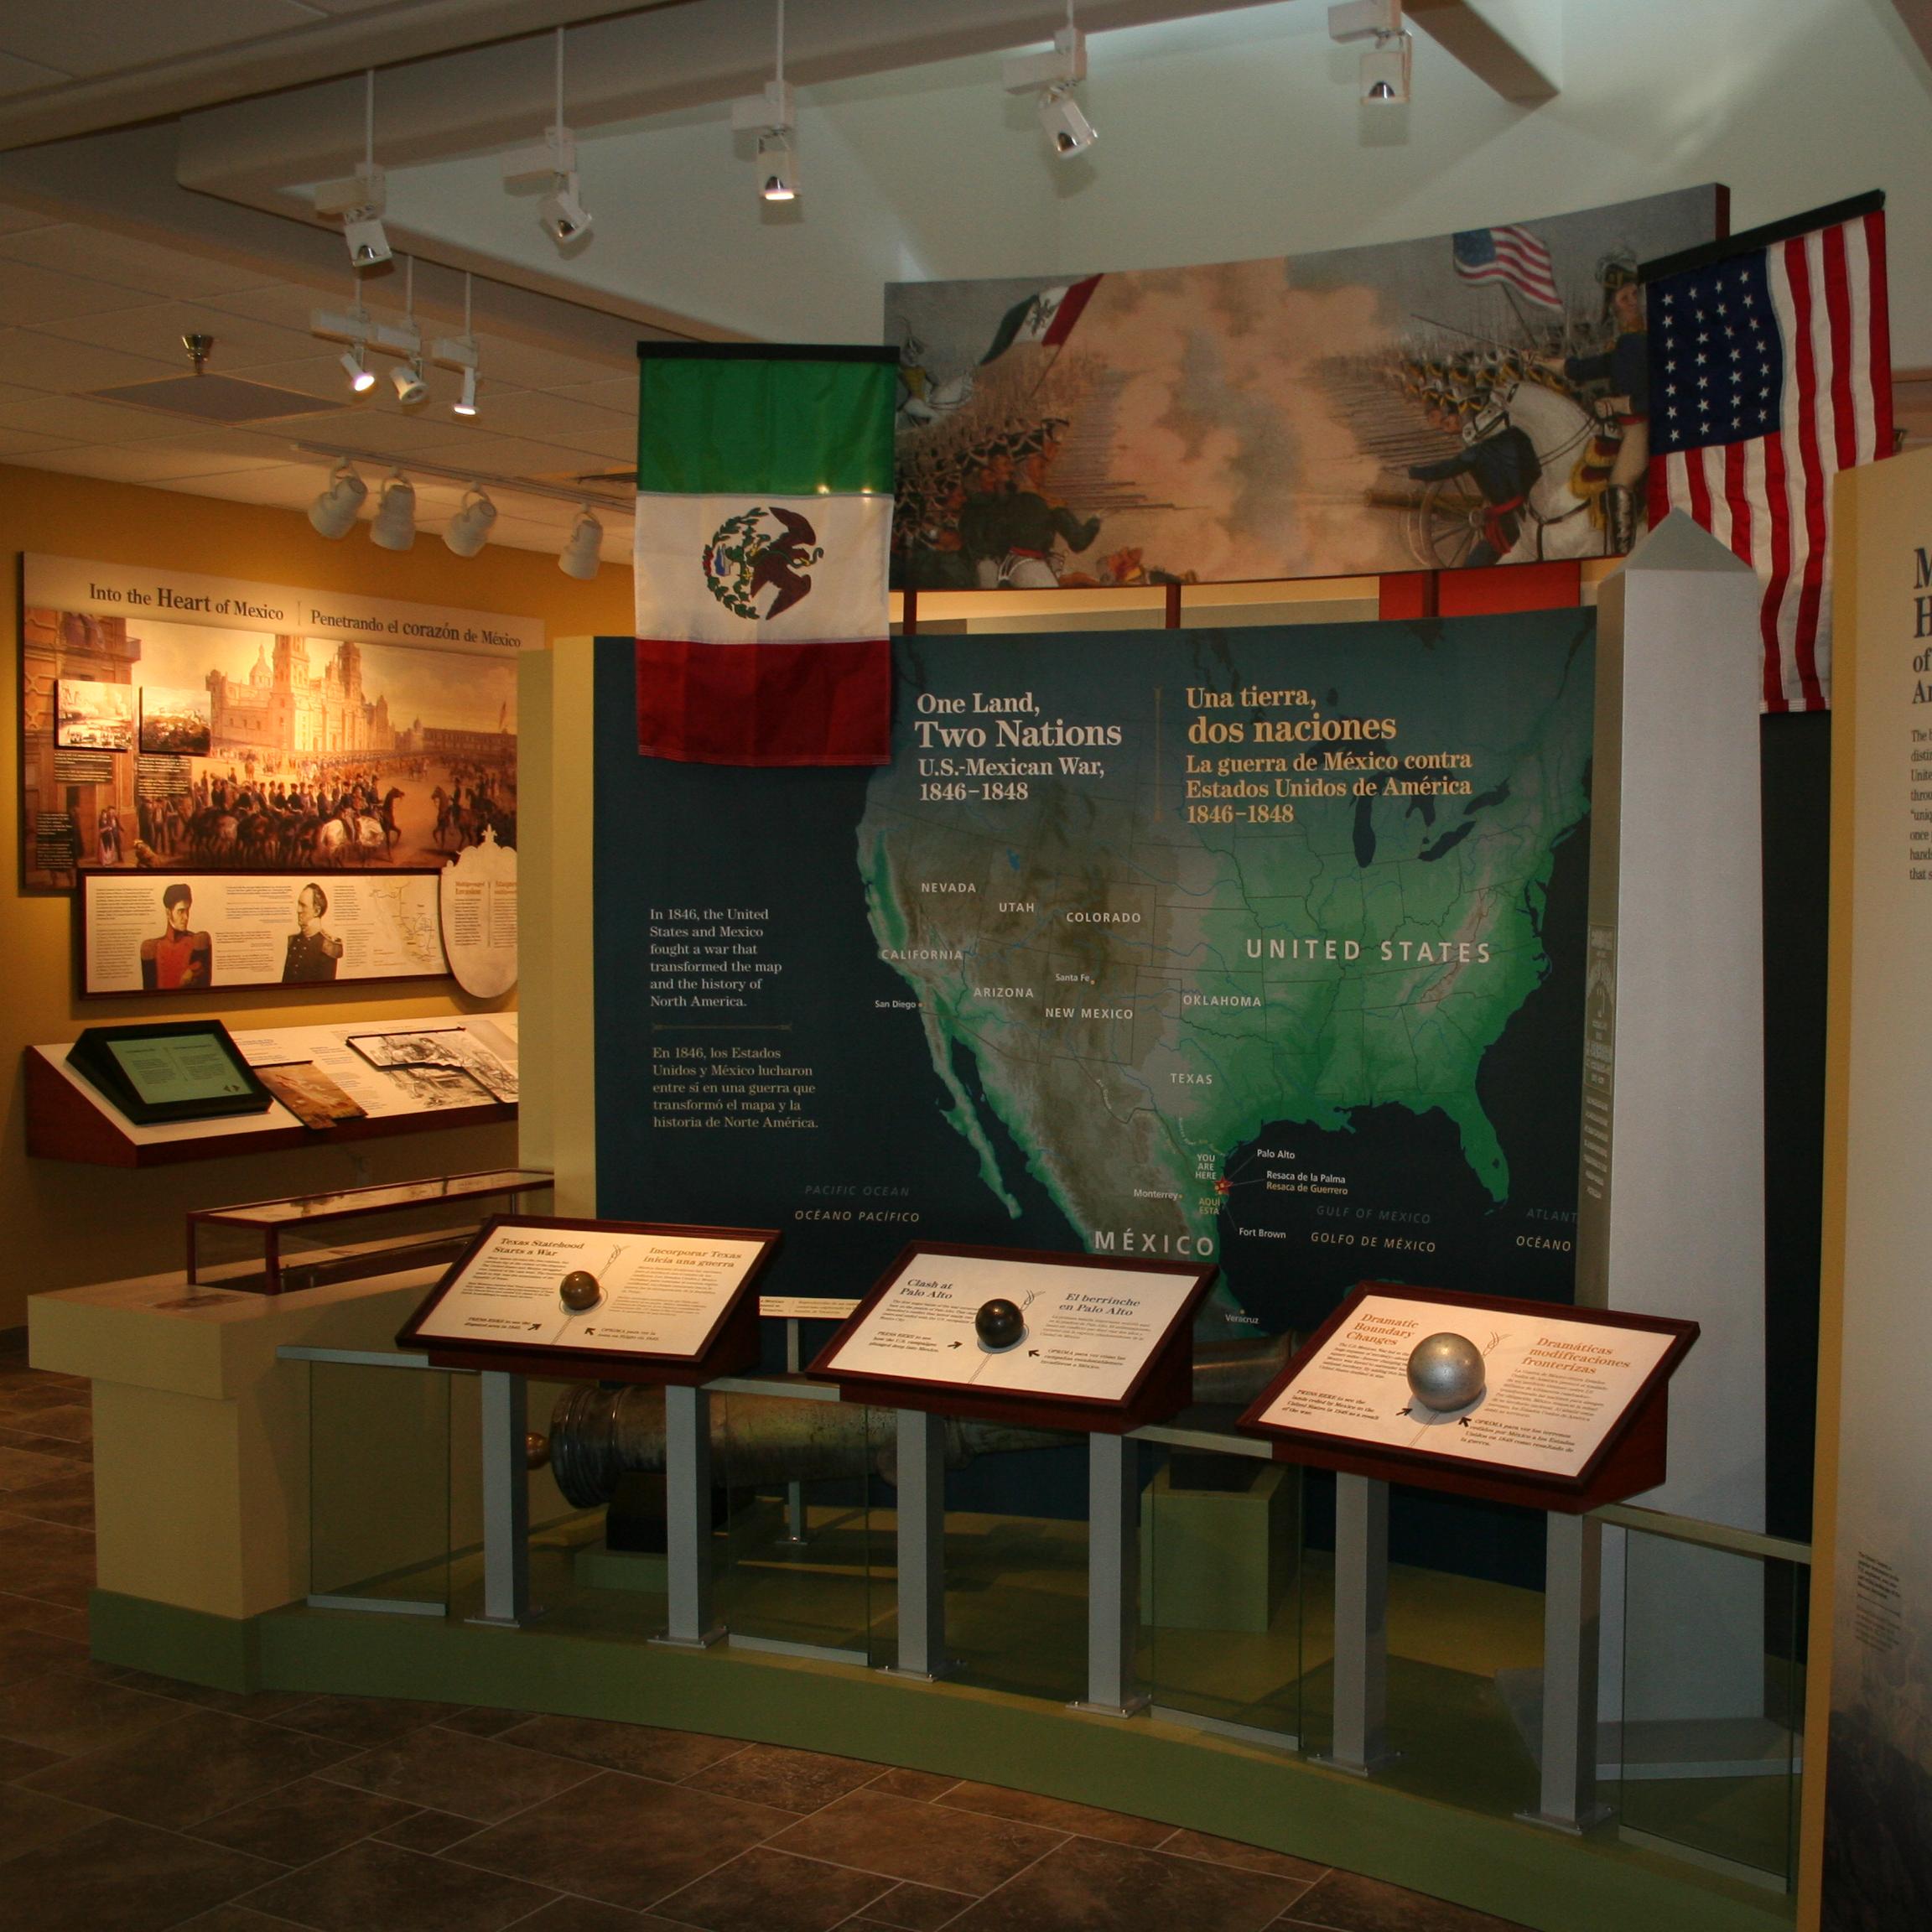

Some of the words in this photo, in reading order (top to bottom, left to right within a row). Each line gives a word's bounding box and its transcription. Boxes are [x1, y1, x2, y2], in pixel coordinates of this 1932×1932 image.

[89, 584, 122, 602] Into
[127, 589, 152, 605] the
[158, 587, 211, 612] Heart
[216, 600, 231, 615] of
[234, 600, 283, 621] Mexico
[311, 610, 383, 632] Penetrando
[388, 620, 398, 634] el
[403, 622, 460, 641] corazón
[464, 631, 478, 643] de
[482, 630, 521, 647] México
[917, 693, 965, 714] One
[973, 692, 1040, 716] Land,
[1186, 688, 1233, 708] Una
[1240, 687, 1317, 709] tierra,
[915, 720, 986, 748] Two
[995, 719, 1122, 747] Nations
[1188, 716, 1244, 744] dos
[1254, 713, 1397, 743] naciones
[918, 758, 1053, 776] U.S.-Mexican
[1059, 756, 1105, 778] War,
[1186, 755, 1213, 773] La
[1218, 761, 1288, 776] guerra
[1292, 753, 1318, 771] de
[1323, 750, 1399, 771] México
[1404, 752, 1472, 771] contra
[1186, 780, 1269, 798] Estados
[1275, 778, 1346, 797] Unidos
[1352, 777, 1378, 797] de
[1383, 776, 1472, 797] América
[922, 882, 977, 893] NEVADA
[999, 902, 1035, 913] UTAH
[650, 909, 663, 920] In
[668, 908, 699, 922] 1846,
[704, 908, 724, 920] the
[727, 908, 769, 920] United
[1067, 912, 1141, 923] COLORADO
[650, 926, 688, 937] States
[692, 926, 715, 937] and
[719, 926, 764, 937] Mexico
[650, 943, 690, 957] fought
[693, 946, 701, 954] a
[704, 946, 729, 954] war
[732, 943, 757, 954] that
[881, 949, 963, 960] CALIFORNIA
[1246, 938, 1360, 960] UNITED
[1380, 940, 1490, 963] STATES
[650, 961, 728, 973] transformed
[731, 961, 752, 973] the
[755, 963, 782, 974] map
[1055, 973, 1078, 982] Santa
[1080, 974, 1090, 982] Fe
[650, 979, 674, 989] and
[678, 979, 698, 989] the
[701, 979, 746, 992] history
[749, 979, 764, 989] of
[974, 987, 1034, 998] ARIZONA
[650, 995, 687, 1006] North
[691, 995, 747, 1006] America.
[875, 1000, 891, 1009] San
[892, 1000, 917, 1010] Diego
[1182, 994, 1261, 1007] OKLAHOMA
[1045, 1008, 1074, 1018] NEW
[1081, 1009, 1133, 1020] MEXICO
[652, 1047, 670, 1058] En
[675, 1047, 707, 1060] 1846,
[710, 1047, 728, 1058] los
[732, 1047, 782, 1059] Estados
[652, 1064, 697, 1076] Unidos
[699, 1067, 707, 1078] y
[711, 1064, 755, 1076] México
[758, 1064, 813, 1076] lucharon
[1171, 1073, 1213, 1085] TEXAS
[652, 1084, 686, 1093] entre
[689, 1082, 699, 1093] sí
[703, 1085, 718, 1093] en
[722, 1085, 745, 1093] una
[749, 1085, 790, 1096] guerra
[792, 1085, 816, 1096] que
[653, 1099, 724, 1111] transformó
[726, 1099, 737, 1111] el
[741, 1103, 775, 1113] mapa
[778, 1103, 787, 1113] y
[790, 1099, 801, 1111] la
[653, 1116, 702, 1128] historia
[705, 1116, 720, 1128] de
[724, 1116, 760, 1128] Norte
[762, 1116, 818, 1128] América.
[1197, 1154, 1215, 1162] YOU
[1257, 1149, 1275, 1159] Palo
[1276, 1150, 1296, 1160] Alto
[1197, 1163, 1214, 1171] ARE
[1195, 1171, 1217, 1180] HERE
[1267, 1171, 1296, 1181] Resaca
[1298, 1172, 1308, 1182] de
[1311, 1172, 1318, 1182] la
[1320, 1173, 1346, 1184] Palma
[805, 1185, 856, 1195] PACIFIC
[863, 1186, 910, 1197] OCEAN
[1134, 1188, 1178, 1200] Monterrey
[1266, 1182, 1296, 1192] Resaca
[1298, 1182, 1308, 1192] de
[1310, 1184, 1348, 1195] Guerrero
[795, 1209, 851, 1221] OCÉANO
[859, 1210, 920, 1223] PACÍFICO
[1317, 1205, 1349, 1217] GULF
[1355, 1208, 1373, 1219] OF
[1379, 1210, 1431, 1224] MEXICO
[1239, 1228, 1256, 1237] Fort
[1259, 1229, 1286, 1239] Brown
[501, 1238, 529, 1246] Texas
[531, 1240, 585, 1249] Statehood
[1094, 1228, 1213, 1256] MÉXICO
[1311, 1233, 1354, 1245] GOLFO
[1361, 1236, 1378, 1248] DE
[1384, 1237, 1436, 1253] MÉXICO
[1516, 1235, 1571, 1252] OCÉANO
[649, 1247, 707, 1257] Incorporar
[710, 1250, 742, 1259] Texas
[907, 1279, 938, 1289] Clash
[900, 1287, 925, 1296] Palo
[926, 1290, 953, 1299] Alto
[1065, 1293, 1079, 1301] El
[1083, 1294, 1140, 1307] berrinche
[1059, 1303, 1073, 1311] en
[1076, 1304, 1103, 1314] Palo
[1105, 1306, 1134, 1317] Alto
[1225, 1313, 1259, 1324] Veracruz
[1361, 1313, 1420, 1329] Dramatic
[1353, 1322, 1415, 1338] Boundary
[1346, 1332, 1398, 1346] Changes
[1536, 1337, 1614, 1355] Dramáticas
[1530, 1348, 1631, 1368] modificaciones
[1521, 1357, 1597, 1375] fronterizas
